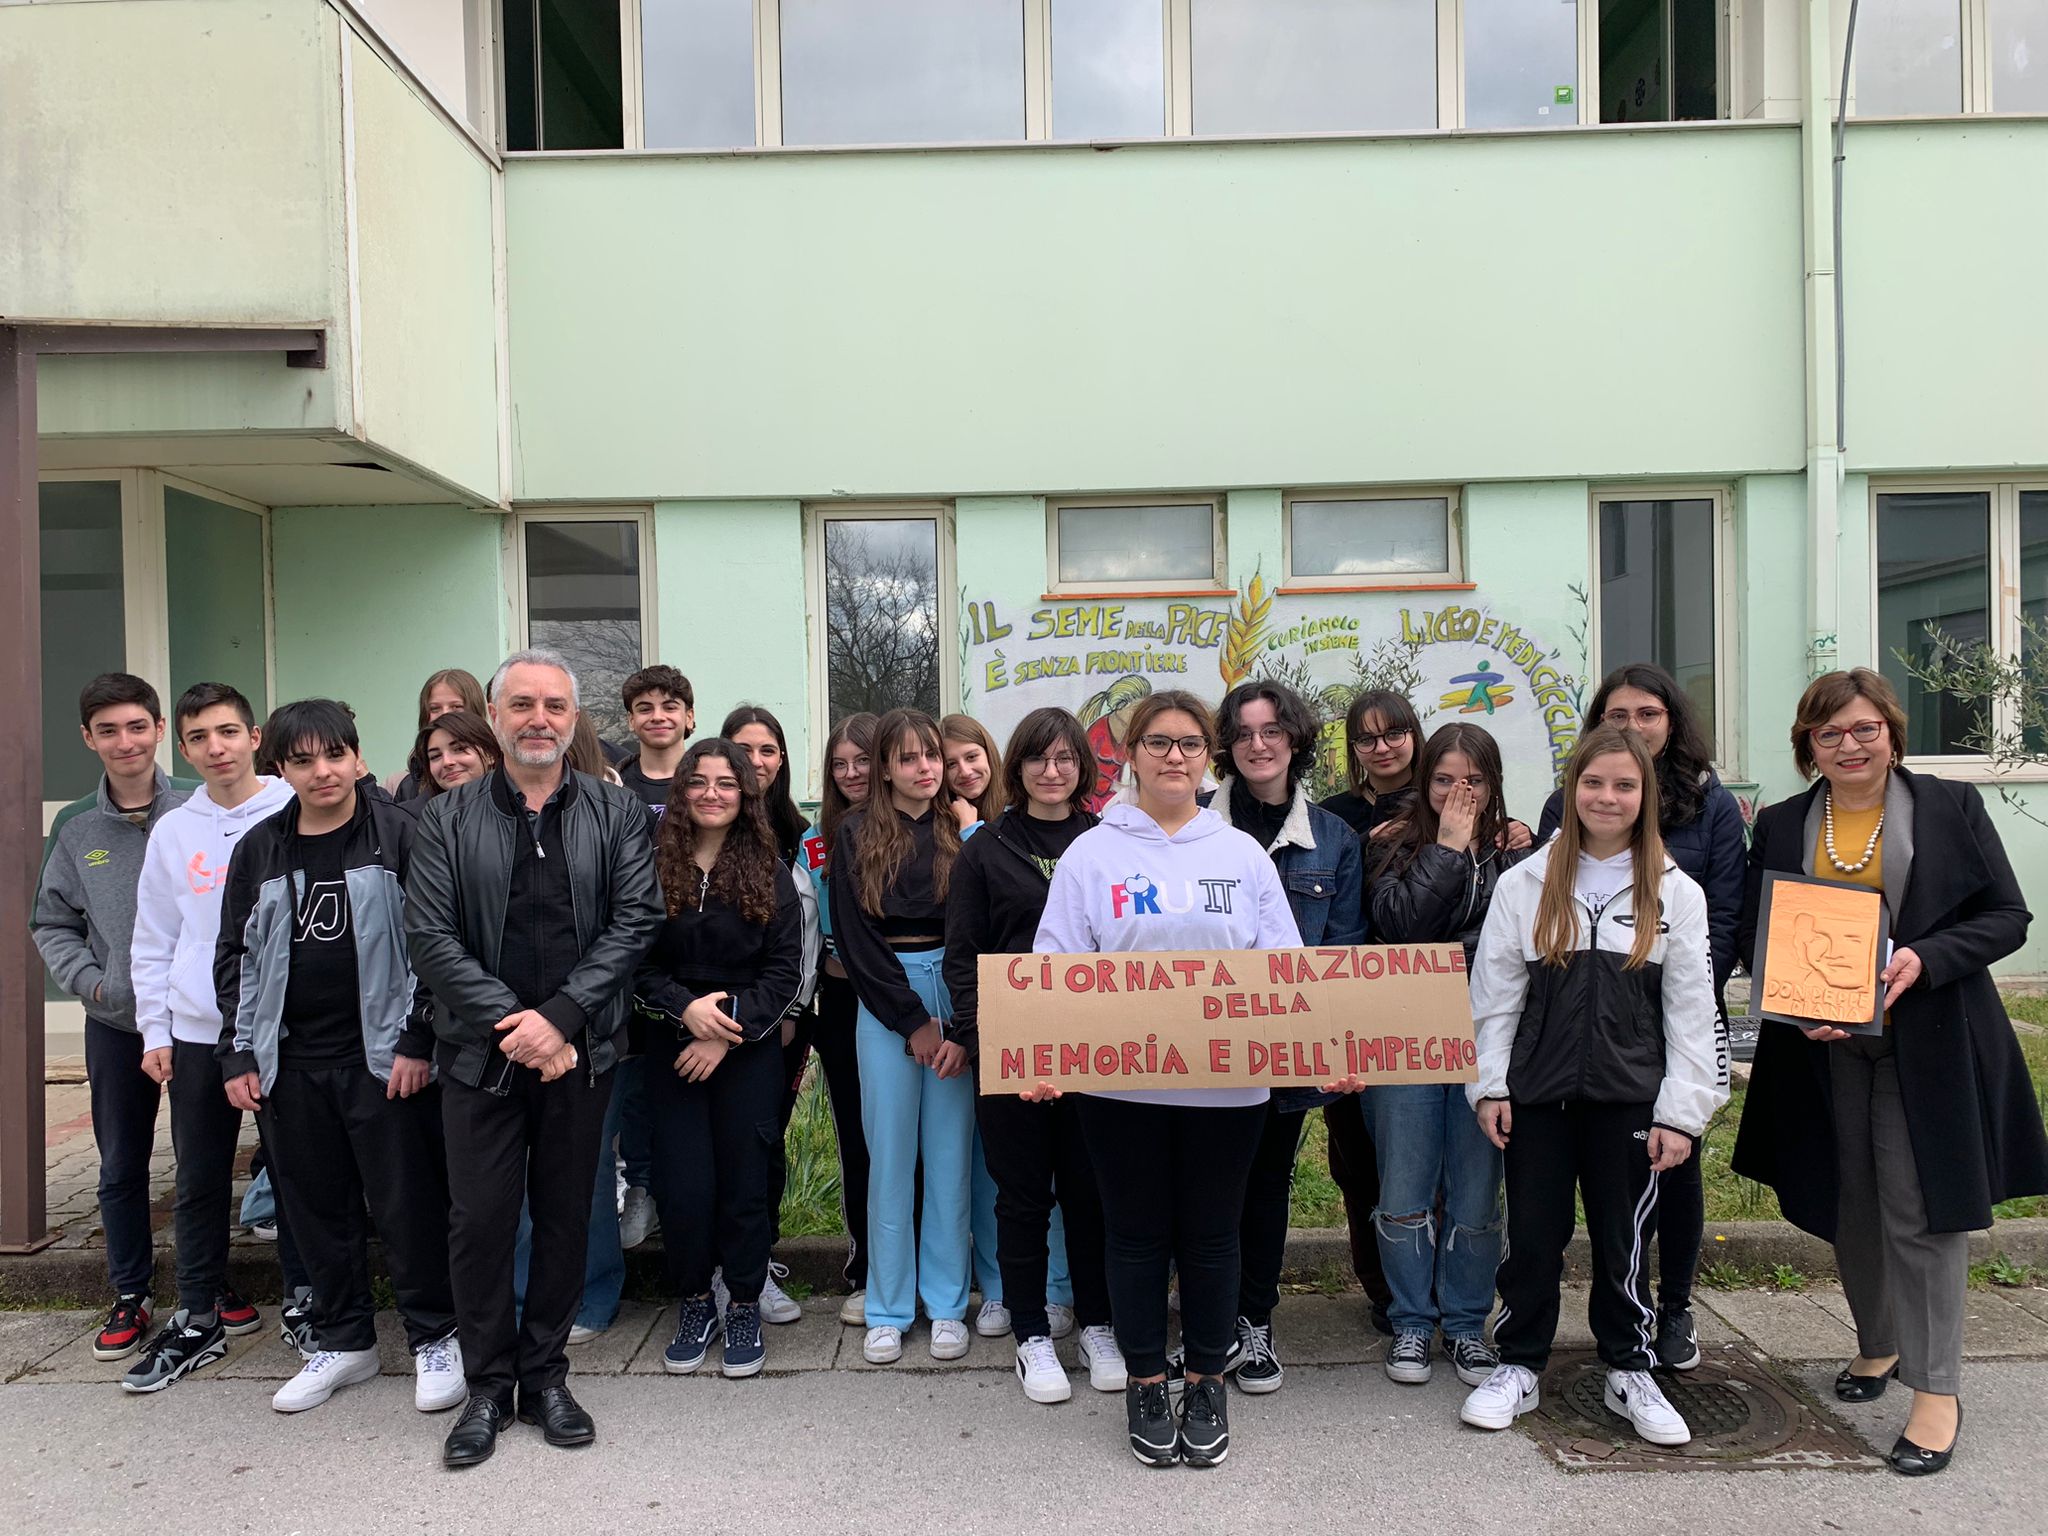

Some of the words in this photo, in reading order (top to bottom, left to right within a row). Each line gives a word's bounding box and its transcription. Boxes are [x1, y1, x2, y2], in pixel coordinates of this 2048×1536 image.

[968, 601, 1012, 645] IL
[1026, 606, 1125, 640] SEME
[1125, 620, 1165, 640] DELLA
[1163, 604, 1230, 648] PACE
[1400, 606, 1481, 645] LICEO
[985, 648, 1009, 693] È
[1014, 656, 1081, 686] SENZA
[1203, 992, 1312, 1020] DELLA
[1767, 979, 1805, 1002] DON
[1208, 1039, 1231, 1073] E
